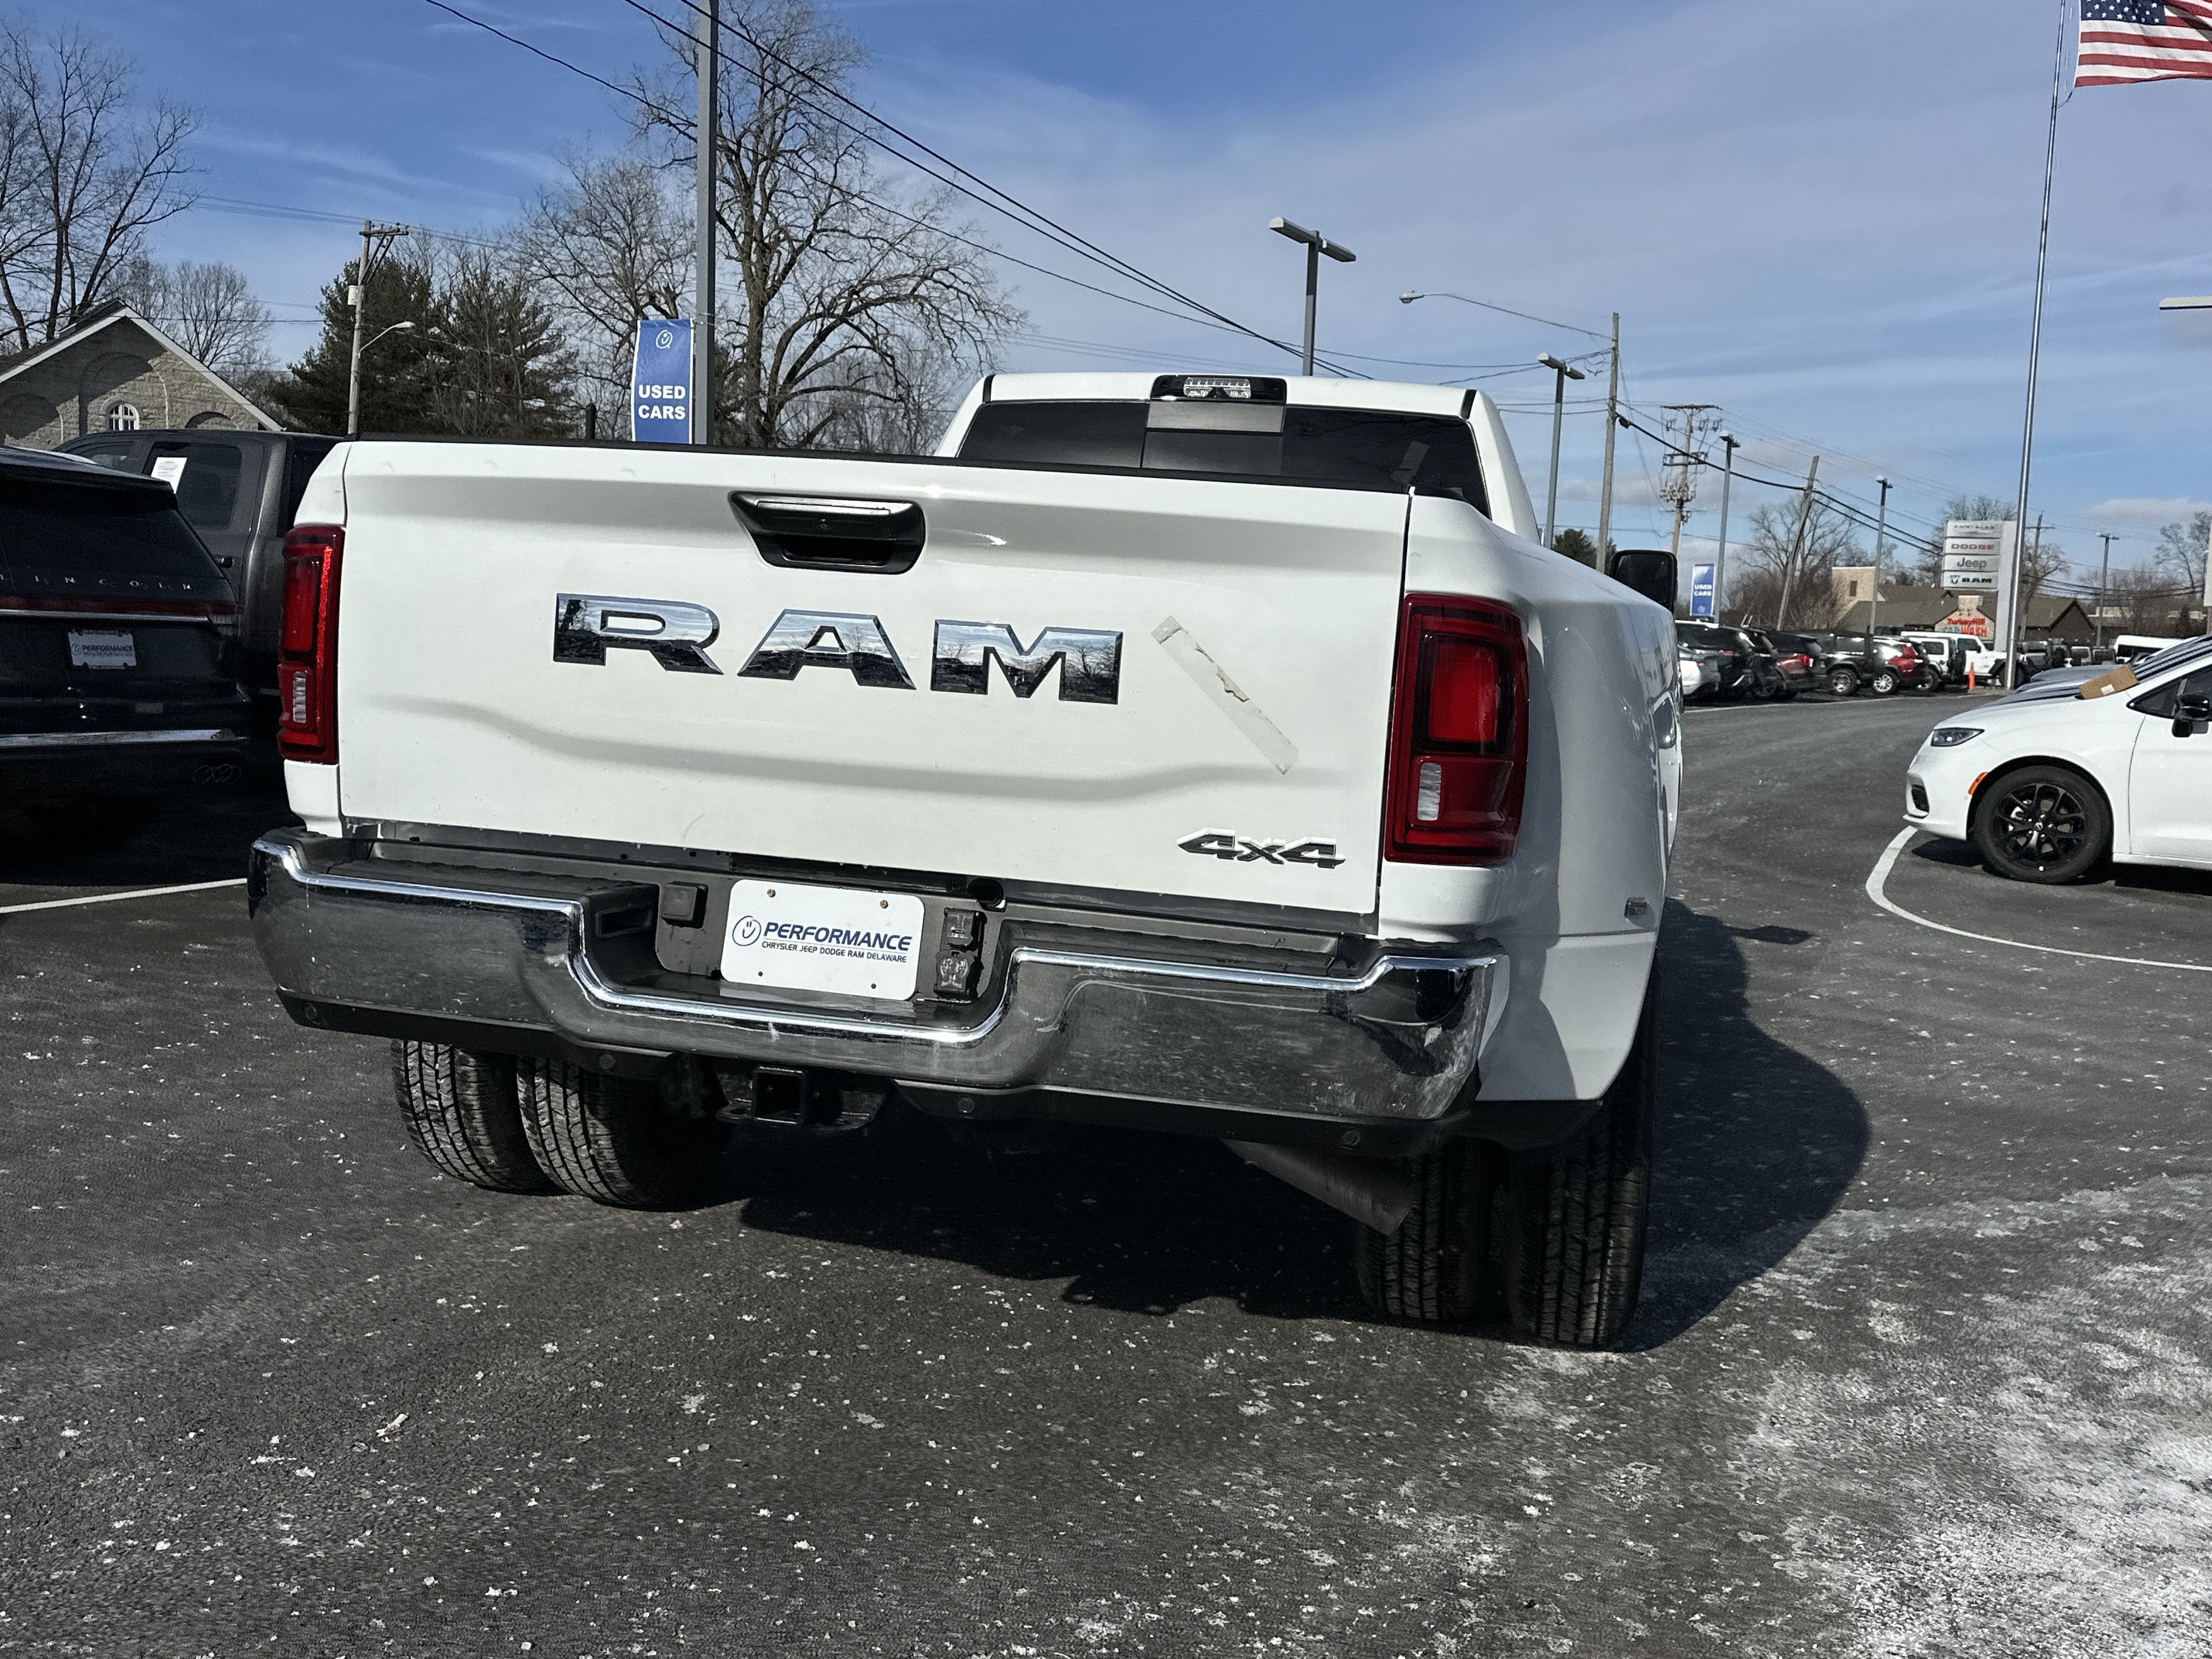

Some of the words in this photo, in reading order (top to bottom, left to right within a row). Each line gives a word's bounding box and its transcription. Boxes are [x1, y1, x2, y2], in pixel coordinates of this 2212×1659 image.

[639, 384, 686, 399] USED
[638, 404, 686, 420] CARS
[1956, 557, 1987, 570] Jeep
[1961, 626, 1987, 636] WASH
[552, 592, 1124, 705] RAM
[763, 921, 912, 951] PERFORMANCE
[761, 941, 798, 952] CHRYSLER
[799, 945, 818, 953] JEEP
[820, 947, 845, 956] DODGE
[848, 950, 865, 958] RAM
[866, 952, 907, 963] DELAWARE
